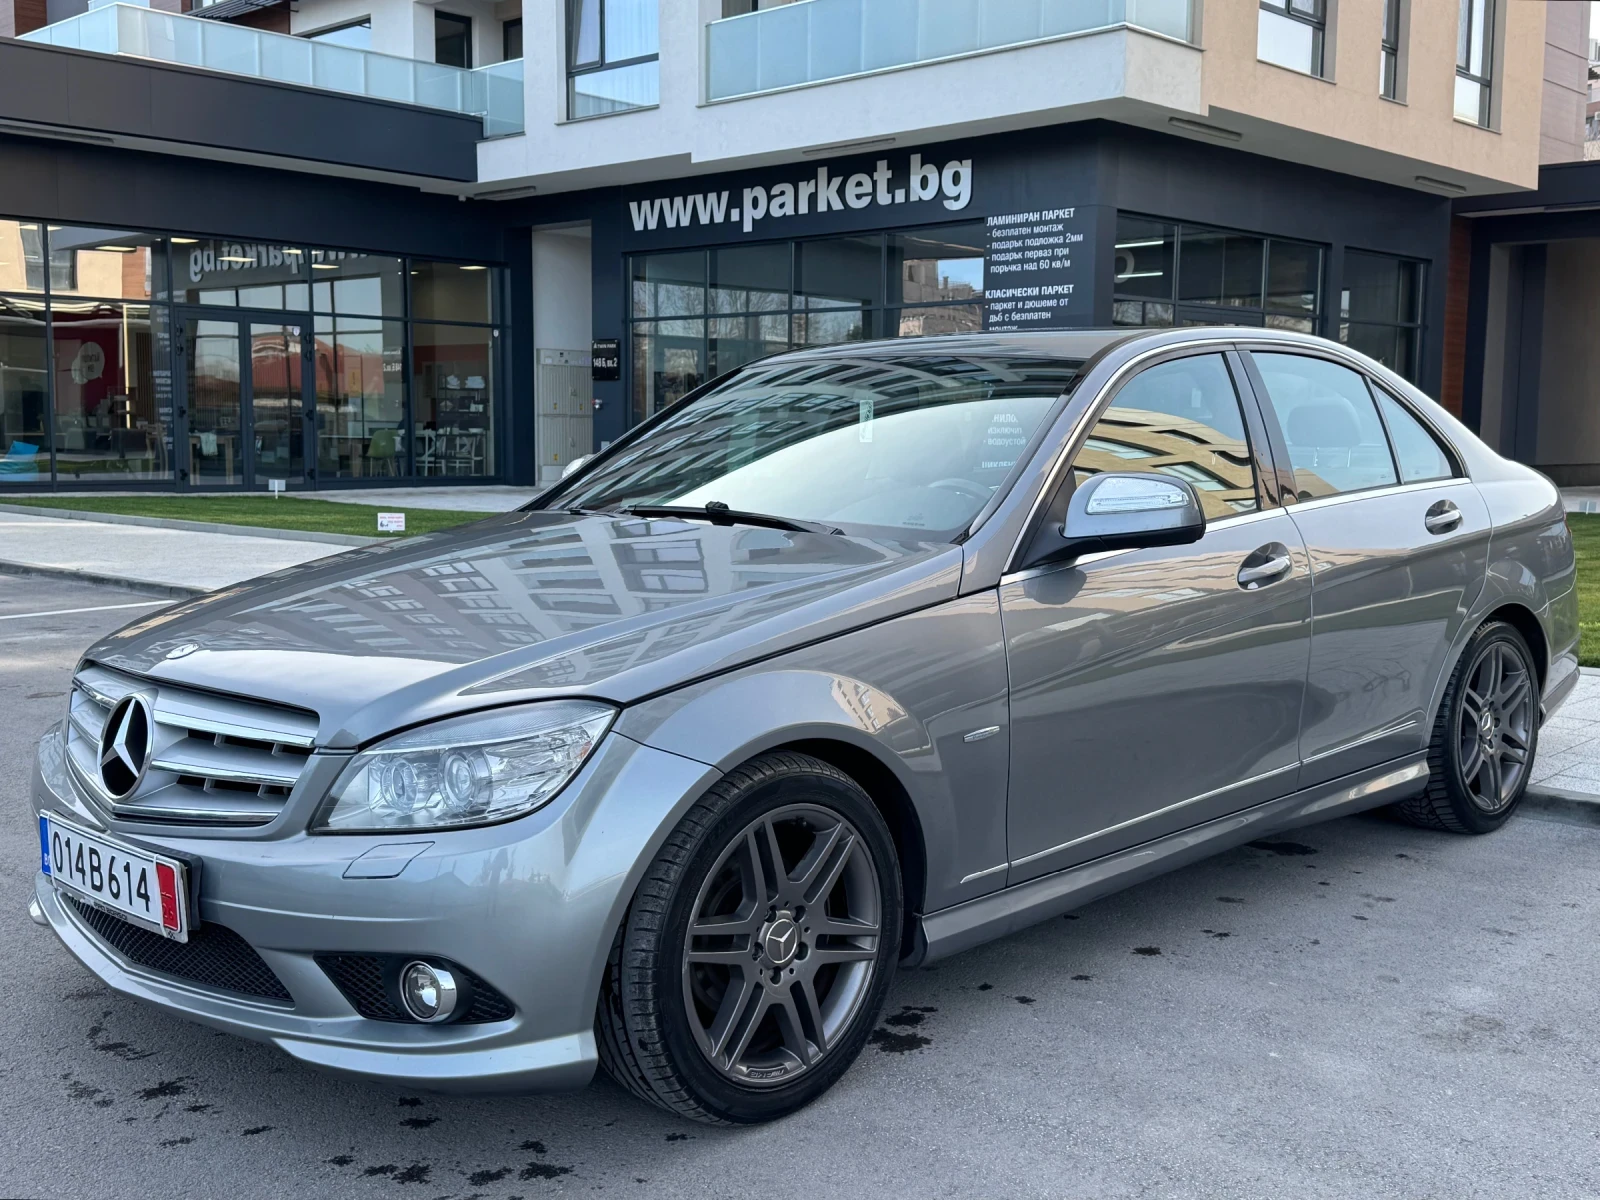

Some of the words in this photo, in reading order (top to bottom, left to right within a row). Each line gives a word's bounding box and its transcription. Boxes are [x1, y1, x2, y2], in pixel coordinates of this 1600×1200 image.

[629, 153, 973, 233] www.parket.bg
[986, 211, 1040, 227] ЛАМИНИРАН
[1042, 207, 1076, 221] ПАРКЕТ
[992, 227, 1032, 238] безплатен
[1033, 222, 1064, 233] монтаж
[1025, 235, 1064, 247] подложка
[1065, 232, 1084, 243] 2мм
[1024, 248, 1053, 260] перваз
[1054, 246, 1070, 258] при
[1023, 261, 1038, 271] над
[1039, 259, 1050, 270] 60
[1051, 258, 1071, 269] кв/м
[985, 286, 1040, 299] КЛАСИЧЕСКИ
[1041, 284, 1075, 296] ПАРКЕТ
[990, 301, 1016, 311] паркет
[1017, 301, 1023, 309] и
[1024, 299, 1058, 309] дюшеме
[1059, 297, 1069, 307] от
[1004, 312, 1010, 322] с
[1011, 310, 1052, 321] безплатен
[53, 831, 151, 913] 014B614
